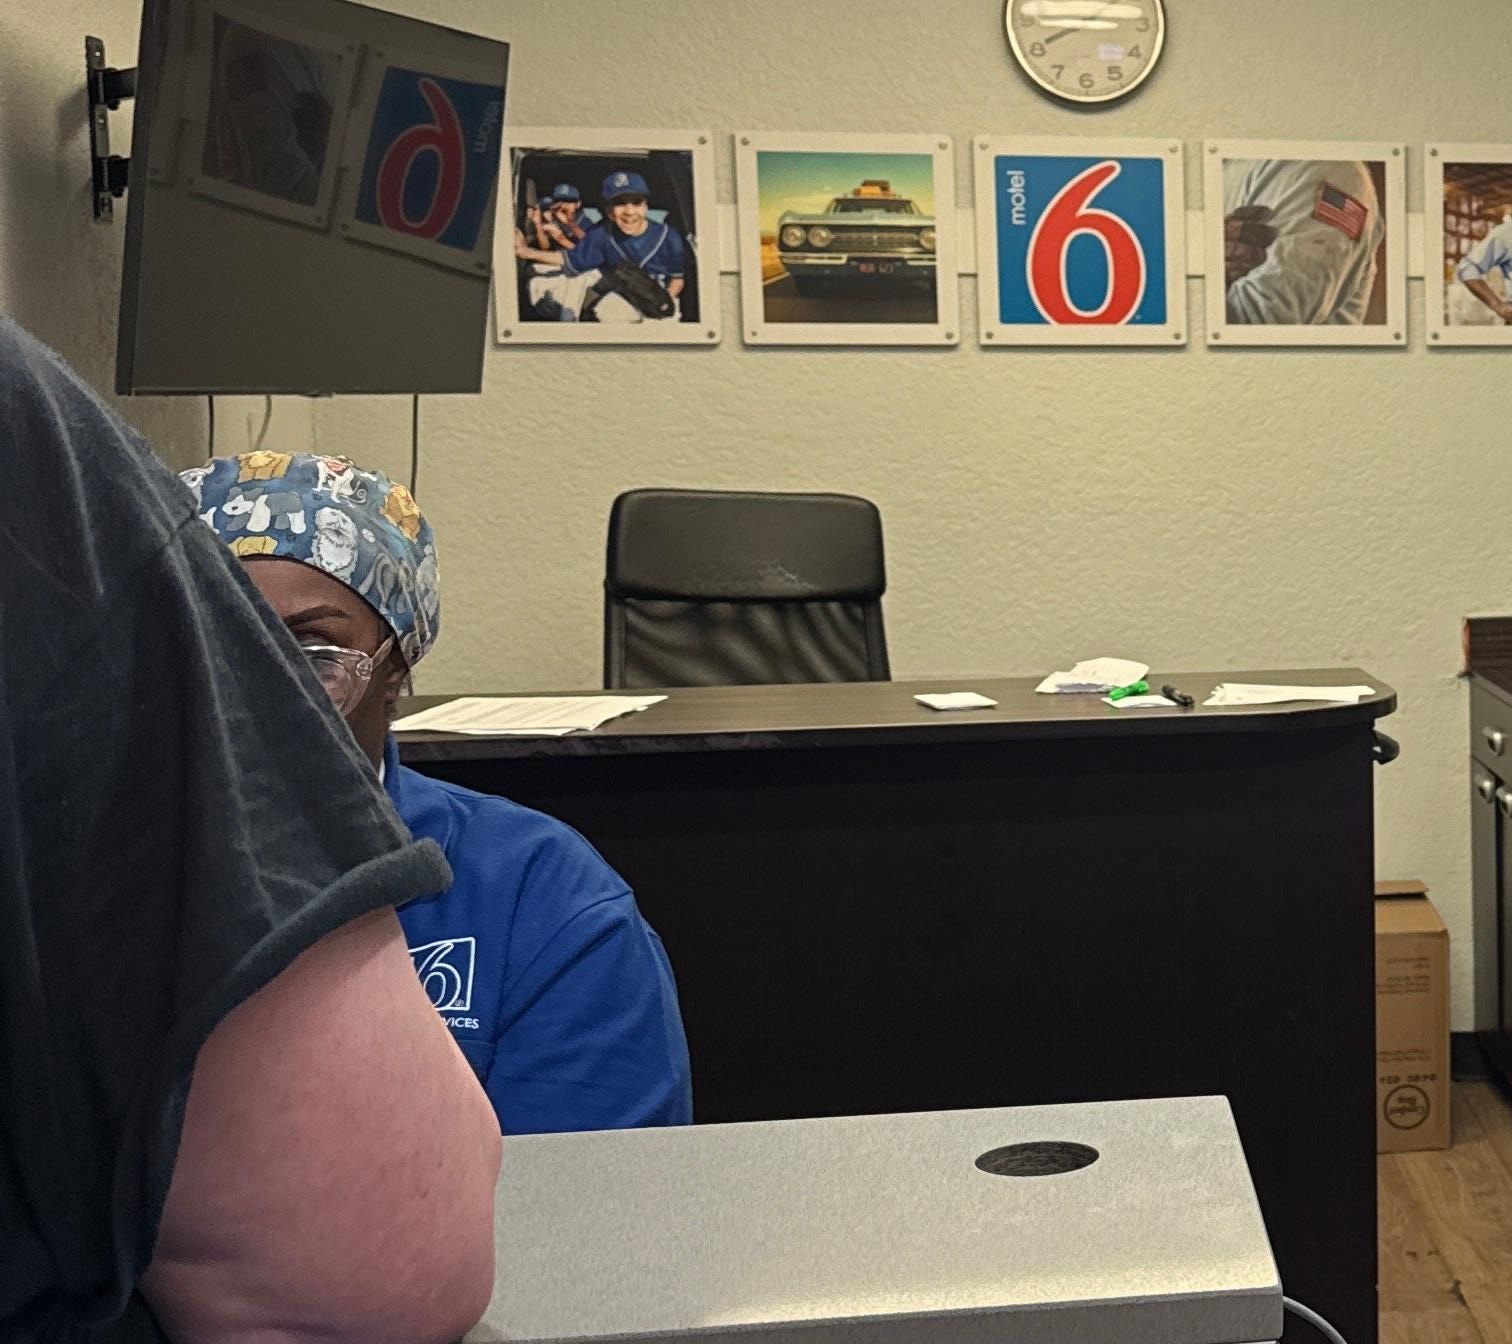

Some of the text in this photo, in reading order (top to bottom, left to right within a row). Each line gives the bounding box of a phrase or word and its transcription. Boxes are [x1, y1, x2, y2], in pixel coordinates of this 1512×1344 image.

[1029, 42, 1047, 57] 8
[1126, 44, 1142, 58] 4
[1051, 64, 1065, 80] 7
[1106, 65, 1123, 81] 5
[1078, 73, 1095, 89] 6
[1006, 169, 1027, 226] motel
[1026, 160, 1147, 325] 6
[418, 942, 461, 1011] 6
[441, 1016, 480, 1029] VICES
